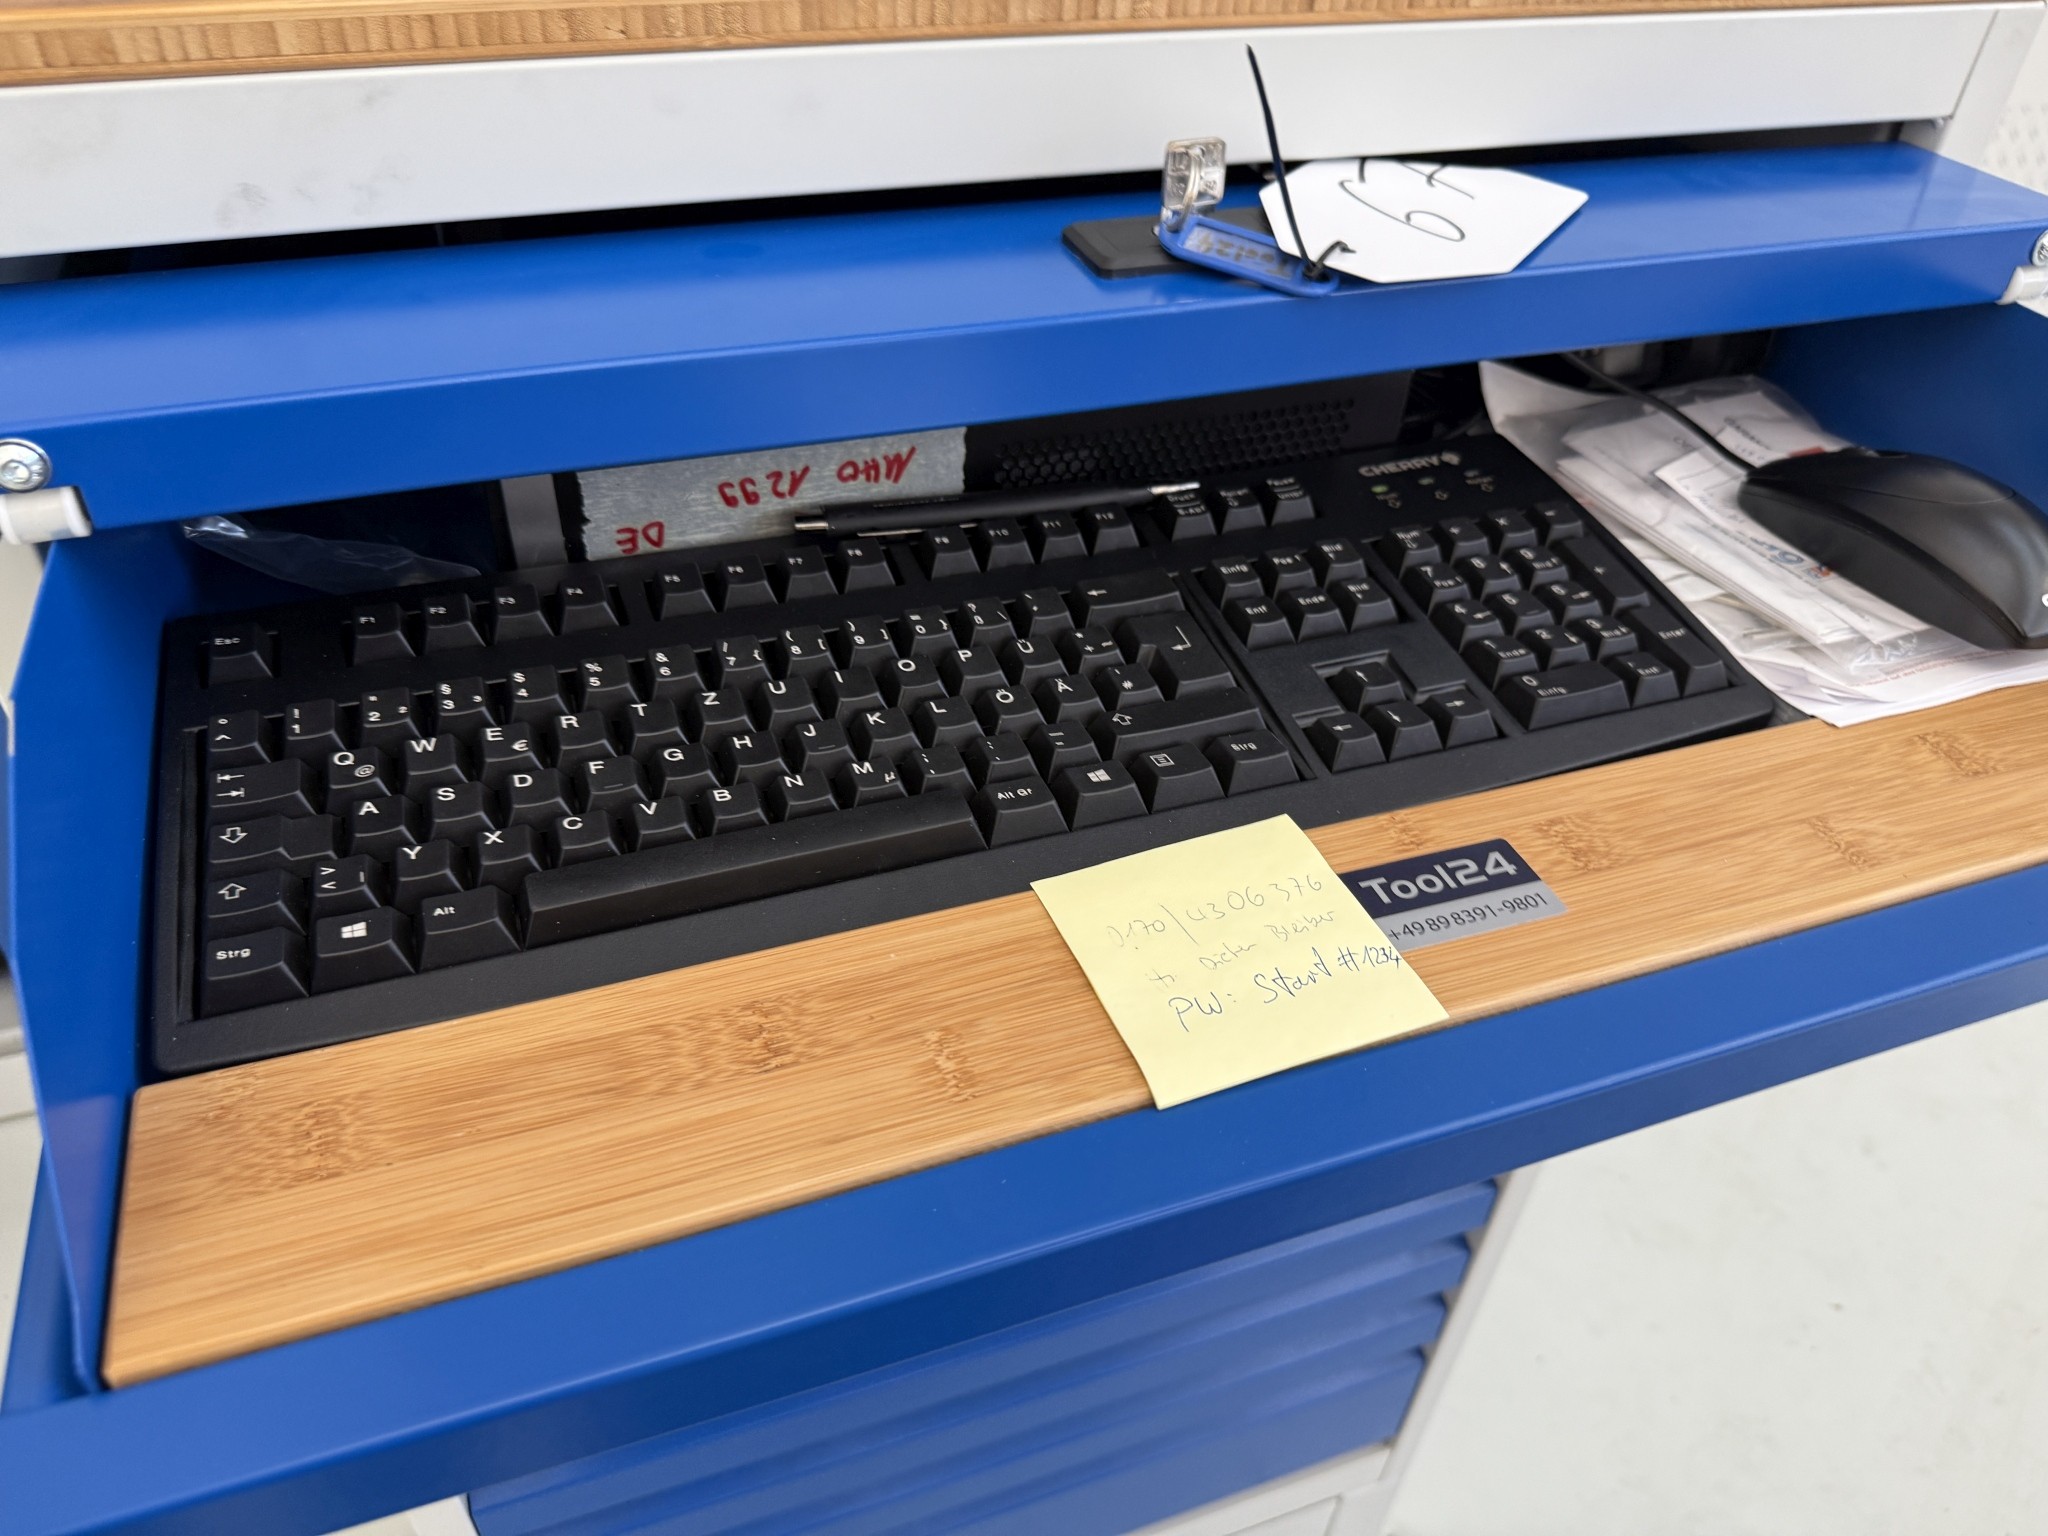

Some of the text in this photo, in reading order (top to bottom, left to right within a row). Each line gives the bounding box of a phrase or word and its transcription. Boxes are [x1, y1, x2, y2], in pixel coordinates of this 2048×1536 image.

[1358, 455, 1441, 477] CHERRY
[1095, 512, 1115, 521] F12
[1042, 520, 1062, 529] F11
[615, 521, 665, 555] DE
[989, 529, 1009, 537] F10
[934, 536, 950, 544] F9
[847, 549, 863, 557] F8
[788, 557, 803, 565] F7
[1272, 557, 1293, 566] Pos
[728, 566, 744, 574] F6
[1220, 564, 1249, 575] Einfg
[1420, 566, 1434, 578] 7
[664, 575, 681, 583] F5
[566, 588, 584, 596] F4
[499, 597, 516, 605] F3
[1298, 595, 1326, 606] Ende
[429, 607, 447, 615] F2
[1245, 605, 1268, 615] Entf
[359, 616, 376, 624] F1
[915, 625, 927, 634] 0
[1658, 628, 1687, 640] Enter
[214, 637, 240, 645] Esc
[854, 635, 865, 645] 9
[790, 645, 802, 655] 8
[1016, 639, 1035, 654] Ü
[655, 652, 670, 663] &
[725, 656, 737, 666] 7
[957, 650, 973, 663] P
[584, 663, 603, 673] %
[659, 666, 672, 676] 6
[898, 659, 917, 672] O
[590, 677, 601, 687] 5
[1054, 678, 1074, 693] Ä
[1521, 675, 1539, 687] 0
[516, 689, 530, 698] 4
[768, 681, 787, 695] U
[702, 692, 721, 706] Z
[995, 689, 1014, 703] Ö
[442, 700, 455, 710] 3
[630, 703, 648, 717] T
[930, 701, 948, 714] L
[368, 711, 381, 722] 2
[560, 716, 580, 729] R
[866, 712, 886, 725] K
[292, 724, 301, 734] 1
[485, 727, 504, 741] E
[803, 724, 817, 737] J
[410, 737, 437, 753] W
[511, 739, 529, 752] €
[732, 735, 753, 749] H
[1230, 742, 1257, 752] Strg
[333, 752, 355, 766] Q
[663, 748, 685, 762] G
[354, 764, 375, 778] @
[588, 761, 605, 774] F
[852, 762, 874, 774] M
[512, 774, 533, 788] D
[784, 775, 805, 787] N
[436, 787, 456, 801] S
[713, 789, 733, 802] B
[997, 788, 1033, 800] Alt Gr
[358, 801, 380, 815] A
[639, 802, 658, 815] V
[562, 817, 584, 830] C
[483, 831, 504, 845] X
[402, 846, 423, 860] Y
[1358, 851, 1518, 905] Tool24
[432, 906, 456, 916] Alt
[216, 948, 251, 960] Strg
